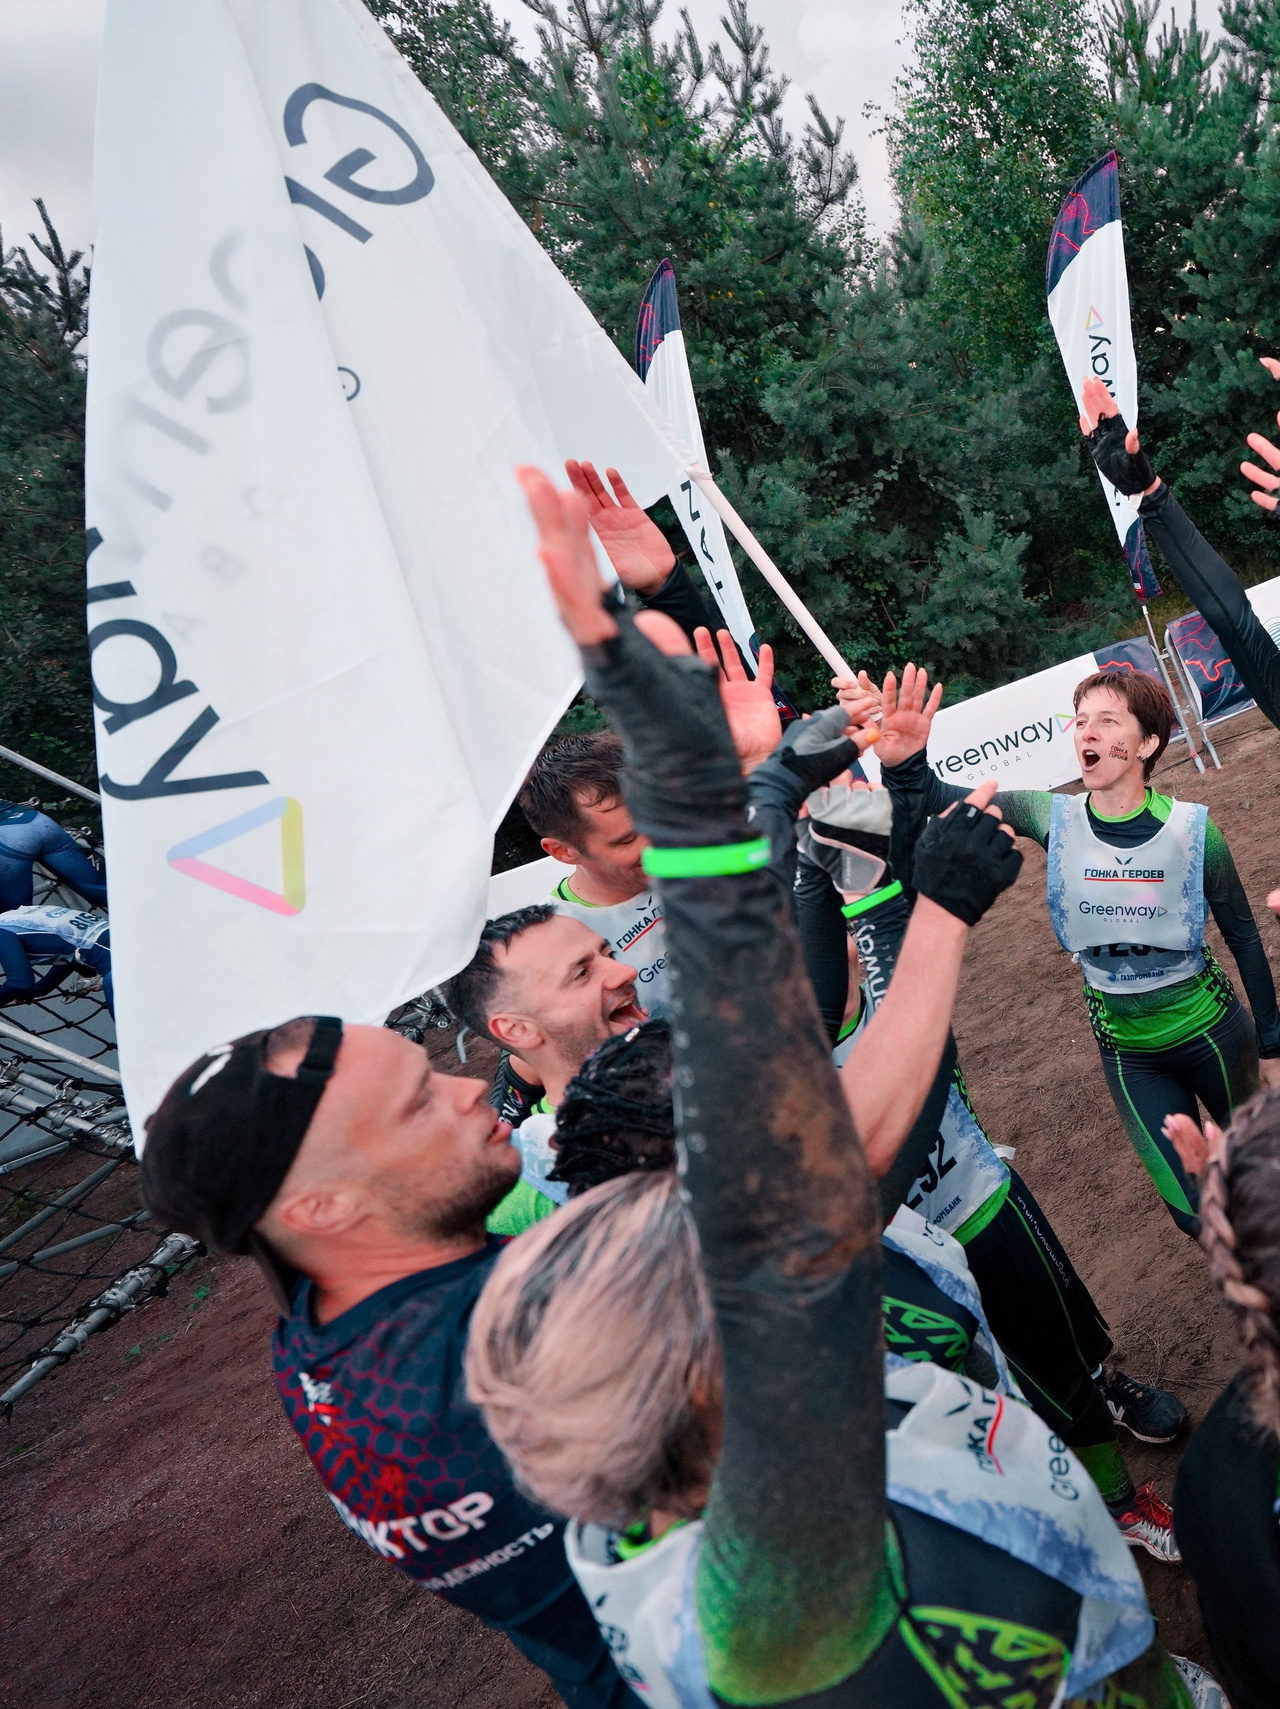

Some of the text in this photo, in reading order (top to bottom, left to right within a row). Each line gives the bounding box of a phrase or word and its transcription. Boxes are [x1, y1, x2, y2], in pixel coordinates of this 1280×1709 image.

[934, 716, 1054, 778] reenway
[967, 751, 1032, 781] GLOBAL
[1084, 868, 1165, 879] ГОНКА ГЕРОЕВ
[1079, 901, 1157, 920] Greenway
[615, 915, 653, 950] ГОНКА
[1048, 1432, 1080, 1501] Gree
